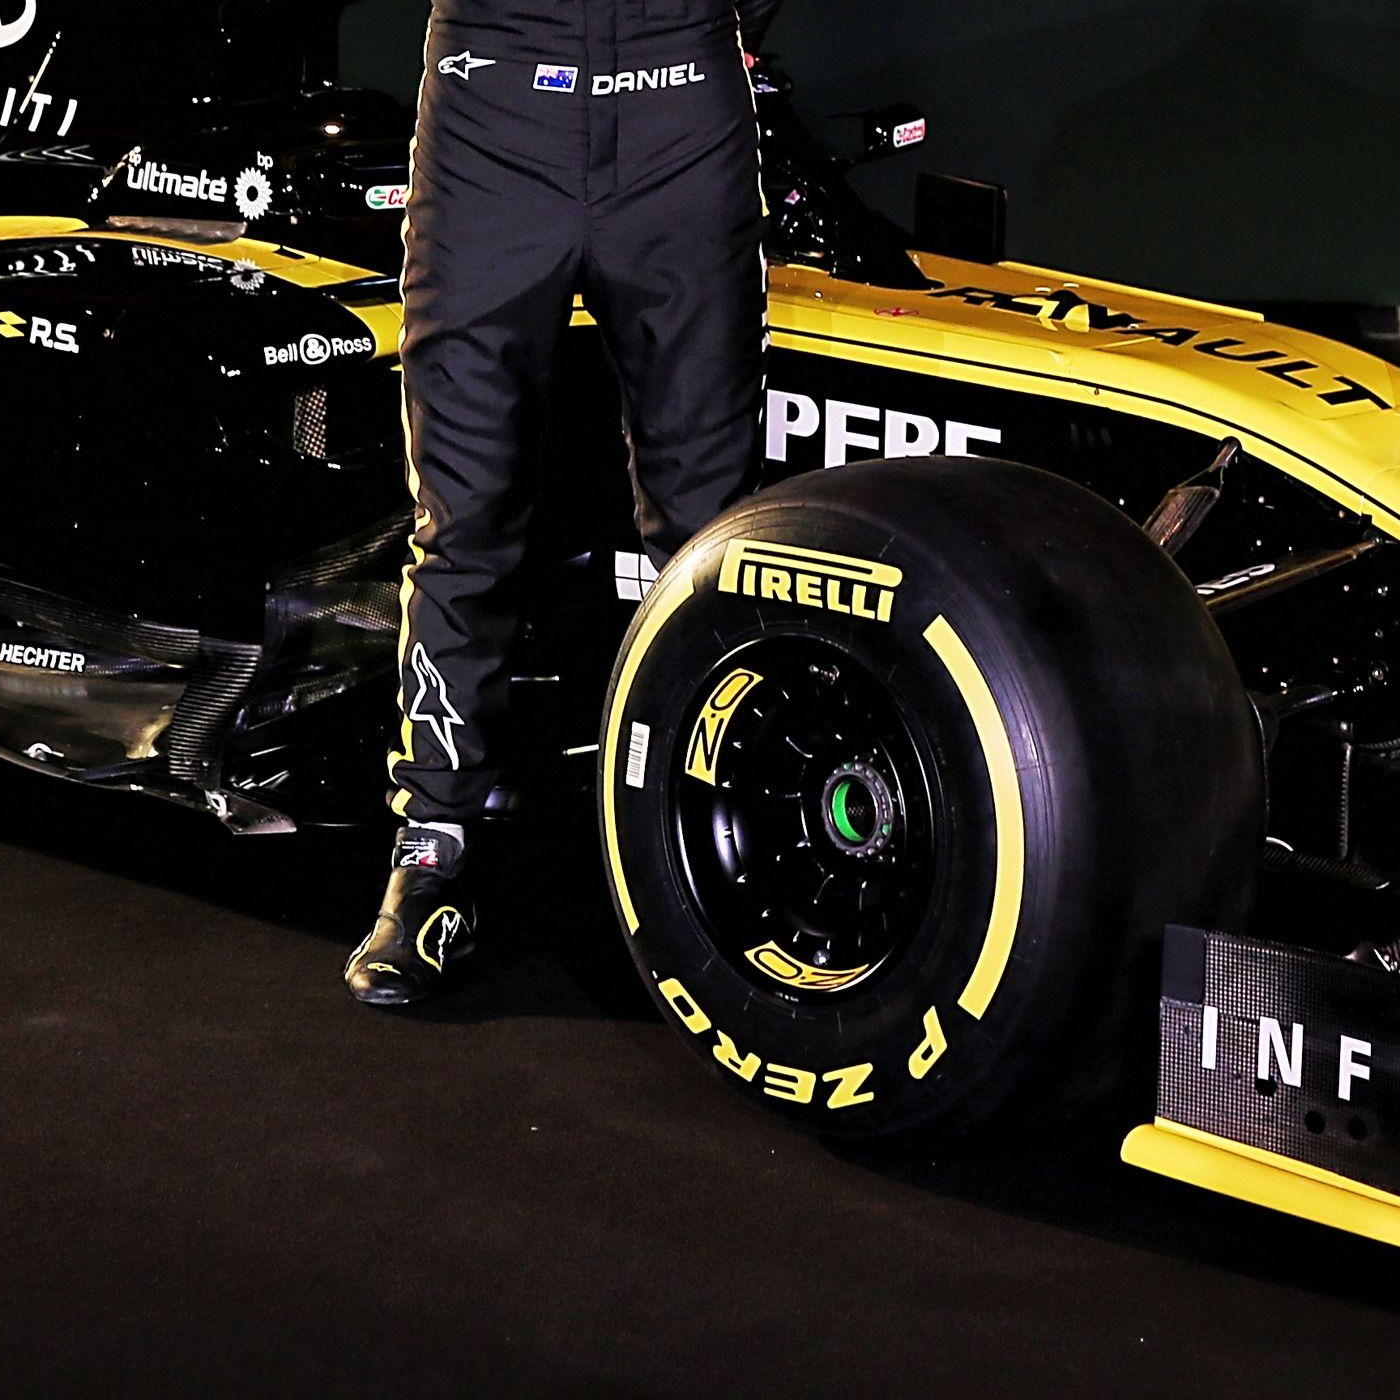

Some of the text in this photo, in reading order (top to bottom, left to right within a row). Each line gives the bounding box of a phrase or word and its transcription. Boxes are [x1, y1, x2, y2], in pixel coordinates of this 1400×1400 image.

[591, 62, 706, 97] DANIEL
[256, 151, 274, 169] bp
[127, 161, 228, 203] ultimate
[263, 335, 373, 366] Bell & Ross
[765, 388, 1002, 470] PFR
[718, 537, 903, 622] PIRELLI
[0, 643, 86, 673] HECHTER
[658, 978, 948, 1109] P ZERO
